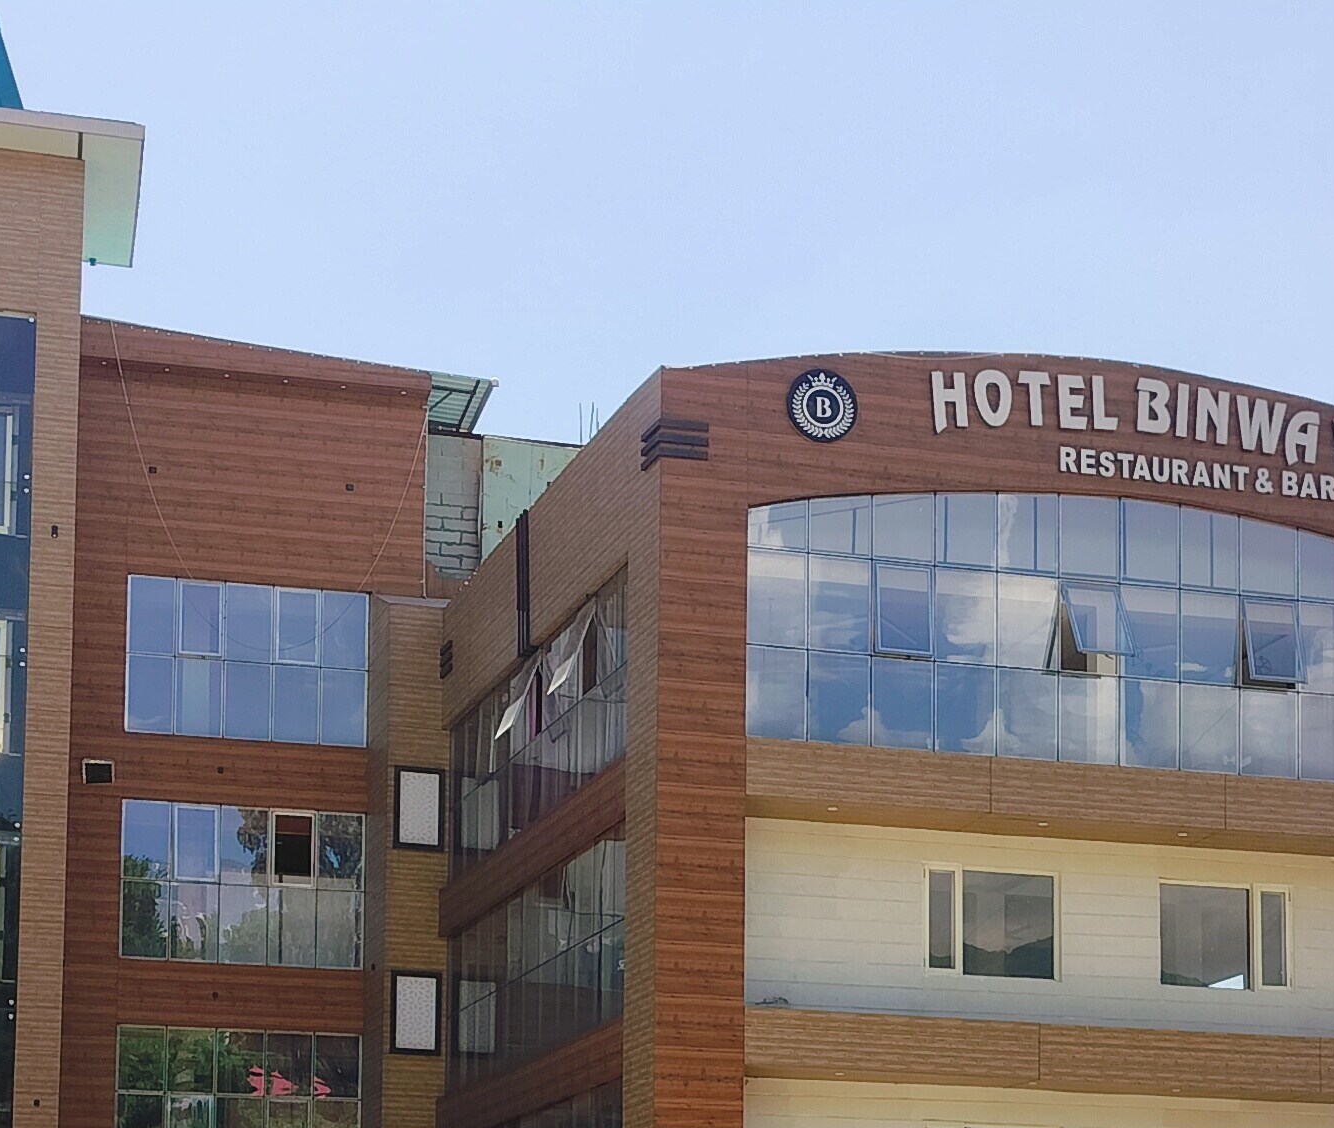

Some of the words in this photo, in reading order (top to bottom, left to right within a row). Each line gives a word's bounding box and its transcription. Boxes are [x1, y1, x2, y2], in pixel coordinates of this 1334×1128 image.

[815, 396, 833, 418] B
[930, 368, 1119, 435] HOTEL
[1135, 376, 1321, 466] BINWA
[1058, 445, 1250, 492] RESTAURANT
[1254, 467, 1275, 494] &
